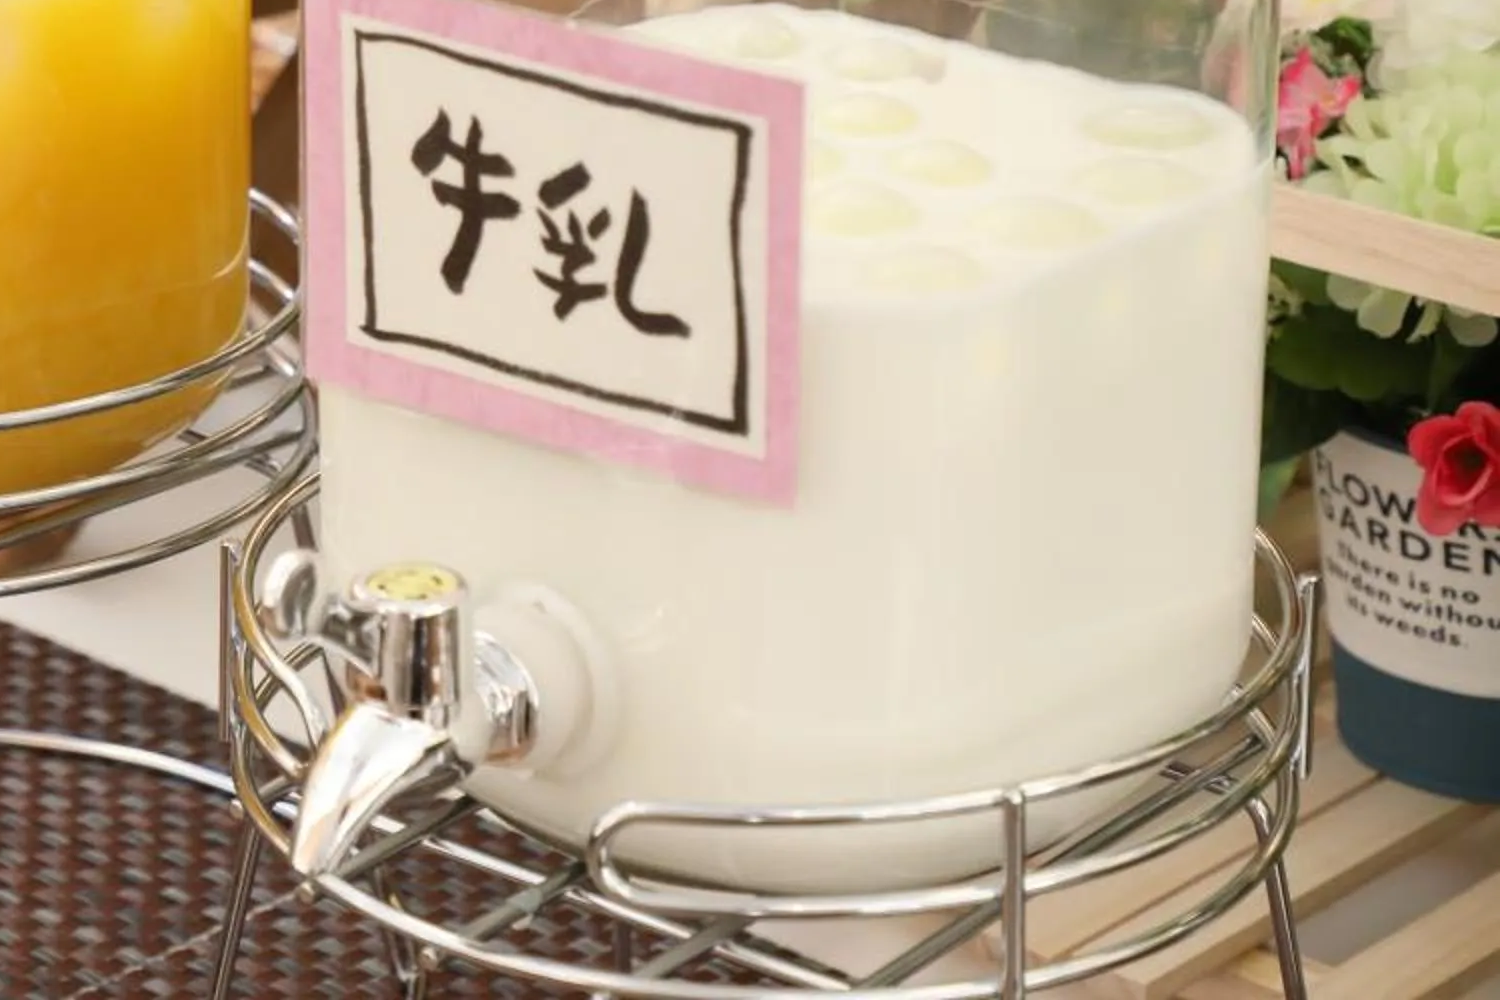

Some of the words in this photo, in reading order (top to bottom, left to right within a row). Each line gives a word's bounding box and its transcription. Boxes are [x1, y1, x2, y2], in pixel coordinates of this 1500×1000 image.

[411, 107, 692, 340] 牛乳
[1408, 571, 1431, 595] is
[1440, 585, 1481, 605] no
